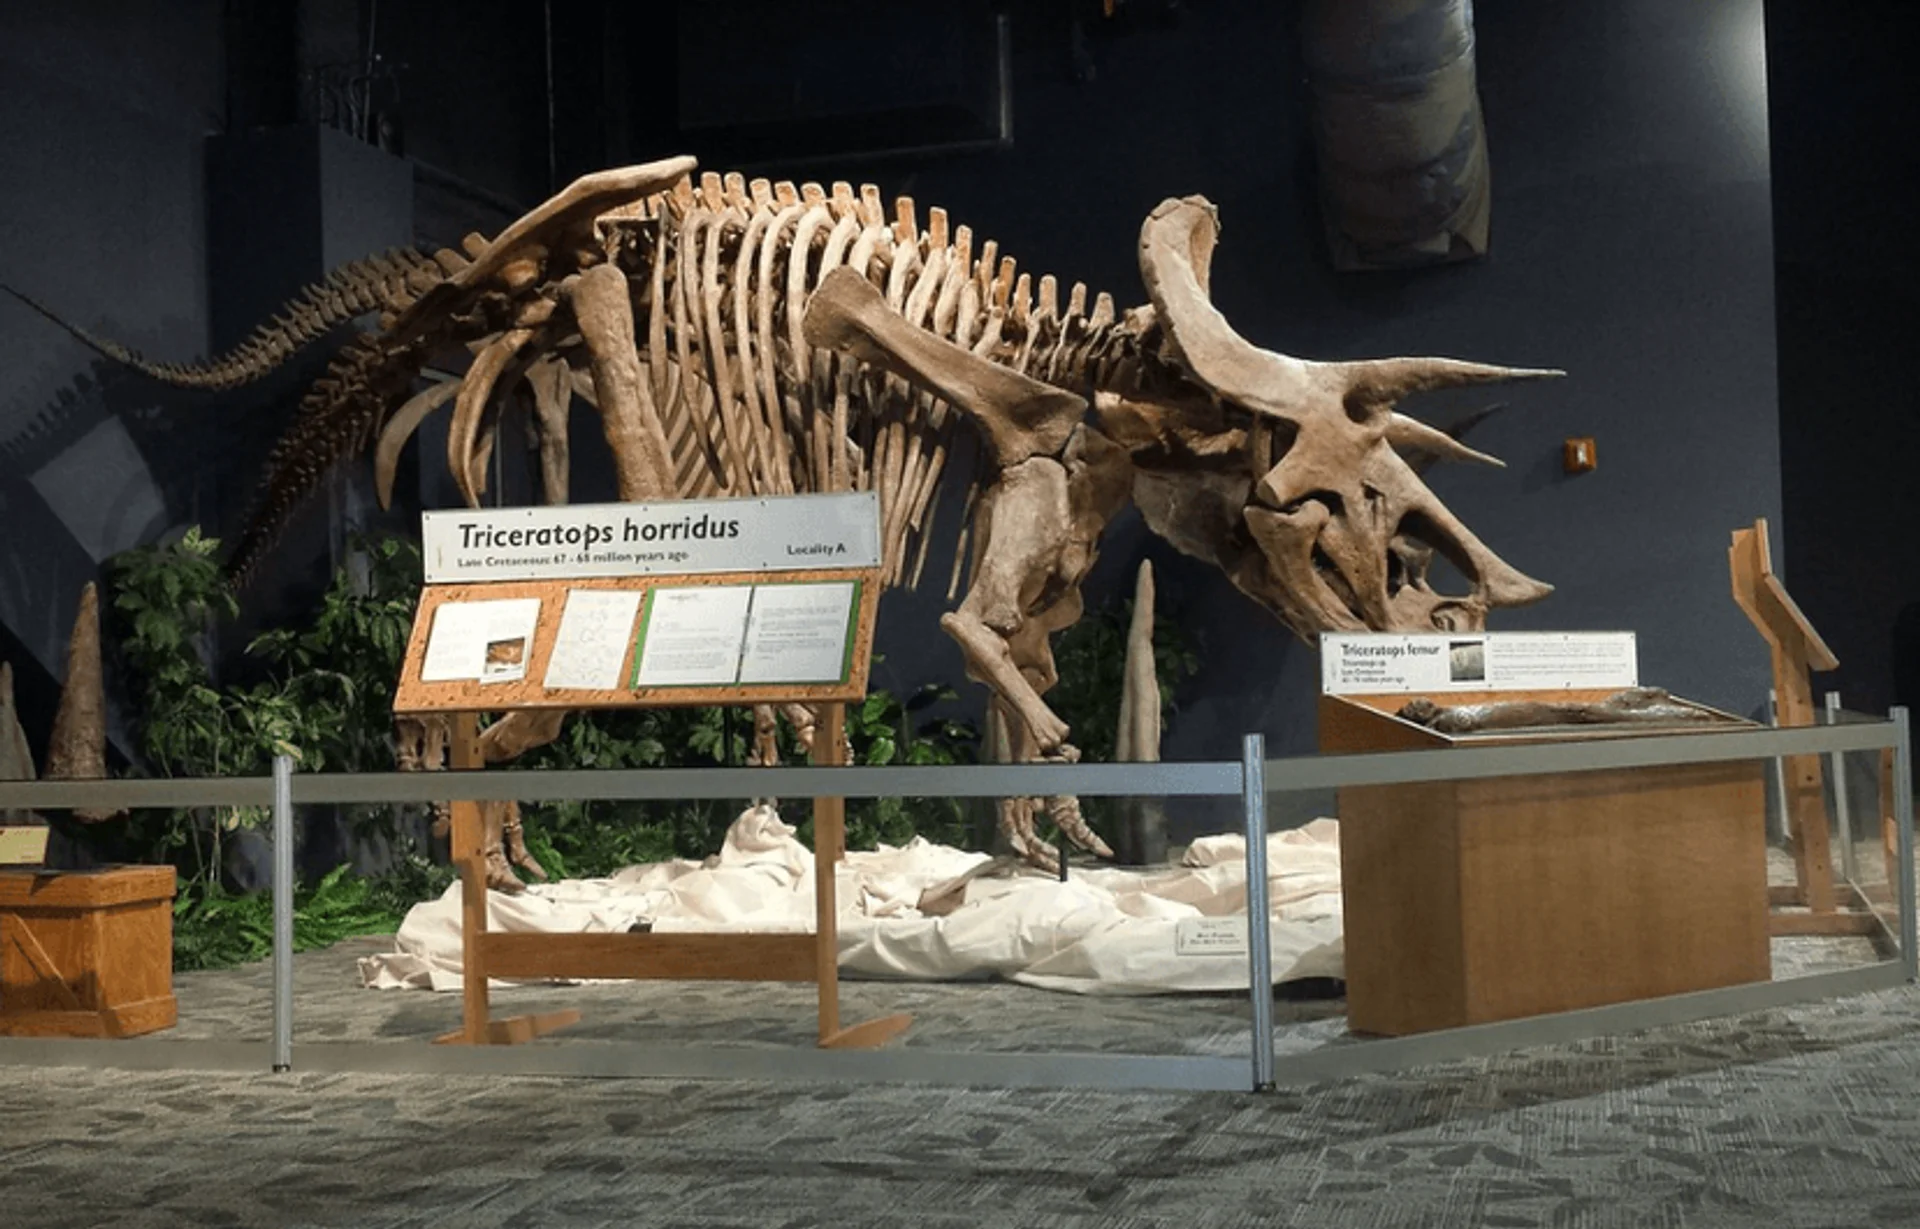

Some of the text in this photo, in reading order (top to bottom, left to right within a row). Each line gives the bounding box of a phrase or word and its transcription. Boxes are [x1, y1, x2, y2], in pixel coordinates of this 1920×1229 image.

[459, 514, 739, 550] Triceratops horridus
[668, 552, 690, 562] ago
[786, 543, 846, 557] Locality A
[1341, 643, 1440, 658] Triceratops femur
